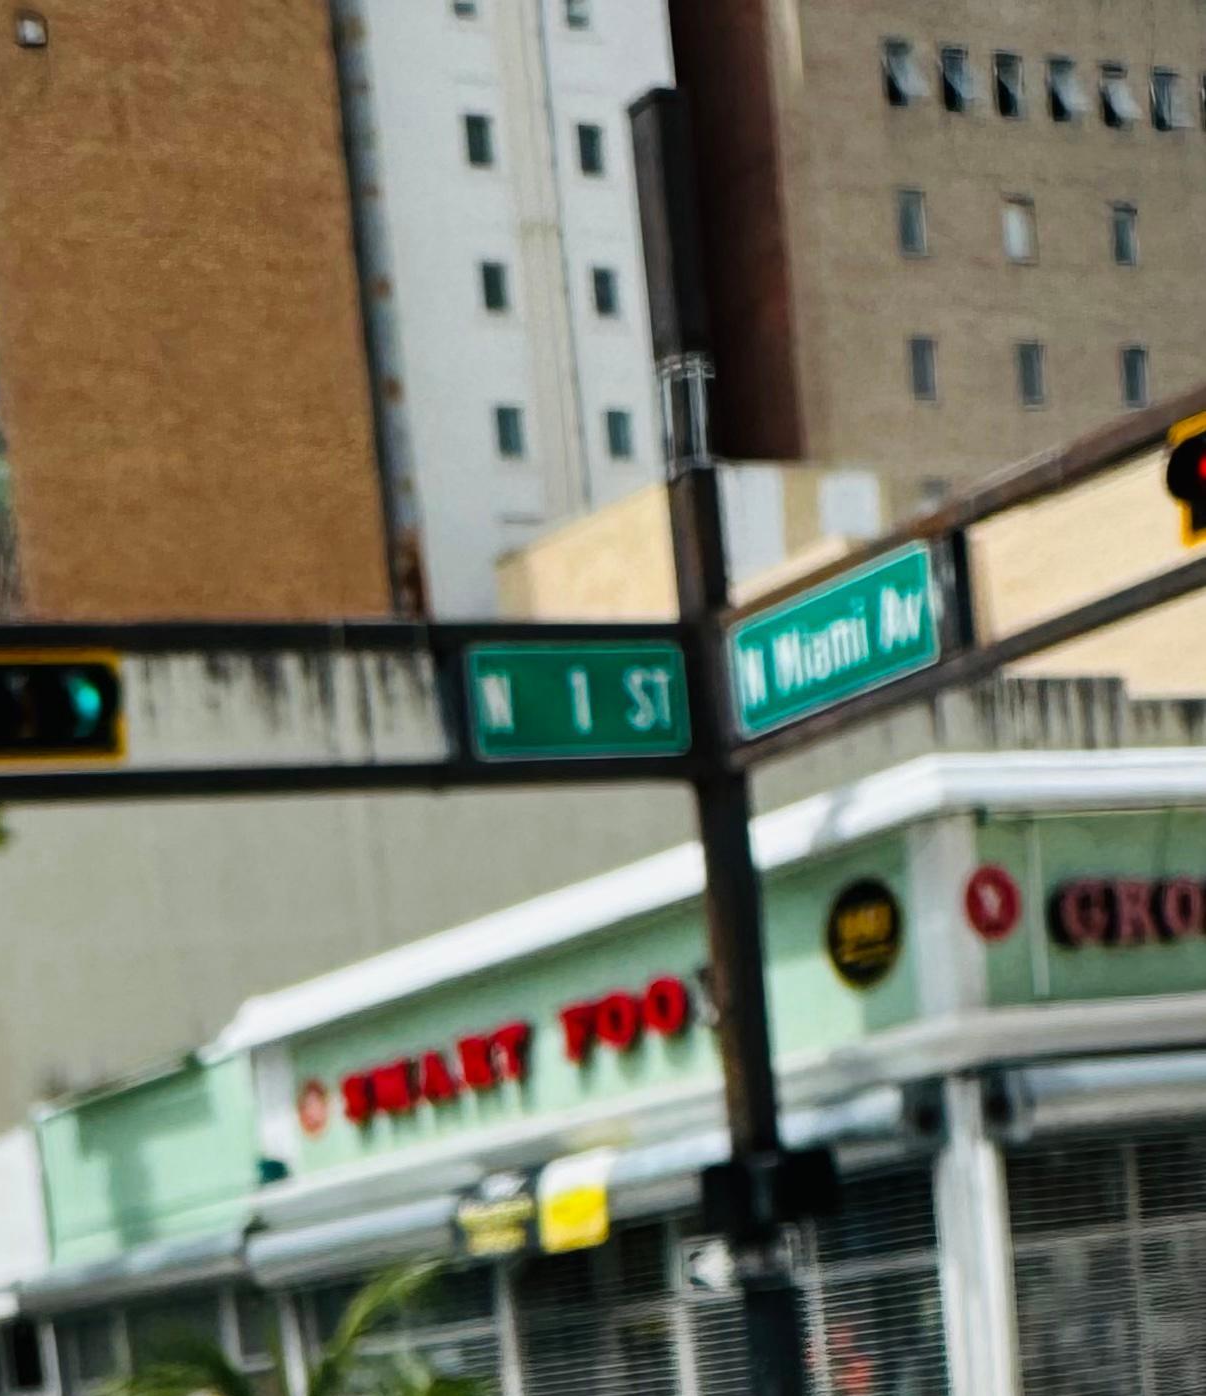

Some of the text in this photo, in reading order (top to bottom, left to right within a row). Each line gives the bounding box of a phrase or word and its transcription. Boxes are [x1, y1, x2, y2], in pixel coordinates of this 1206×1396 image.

[478, 673, 514, 733] N
[623, 664, 672, 731] ST
[739, 646, 767, 707] N
[773, 597, 870, 693] Miami
[340, 974, 688, 1127] SMART FOO
